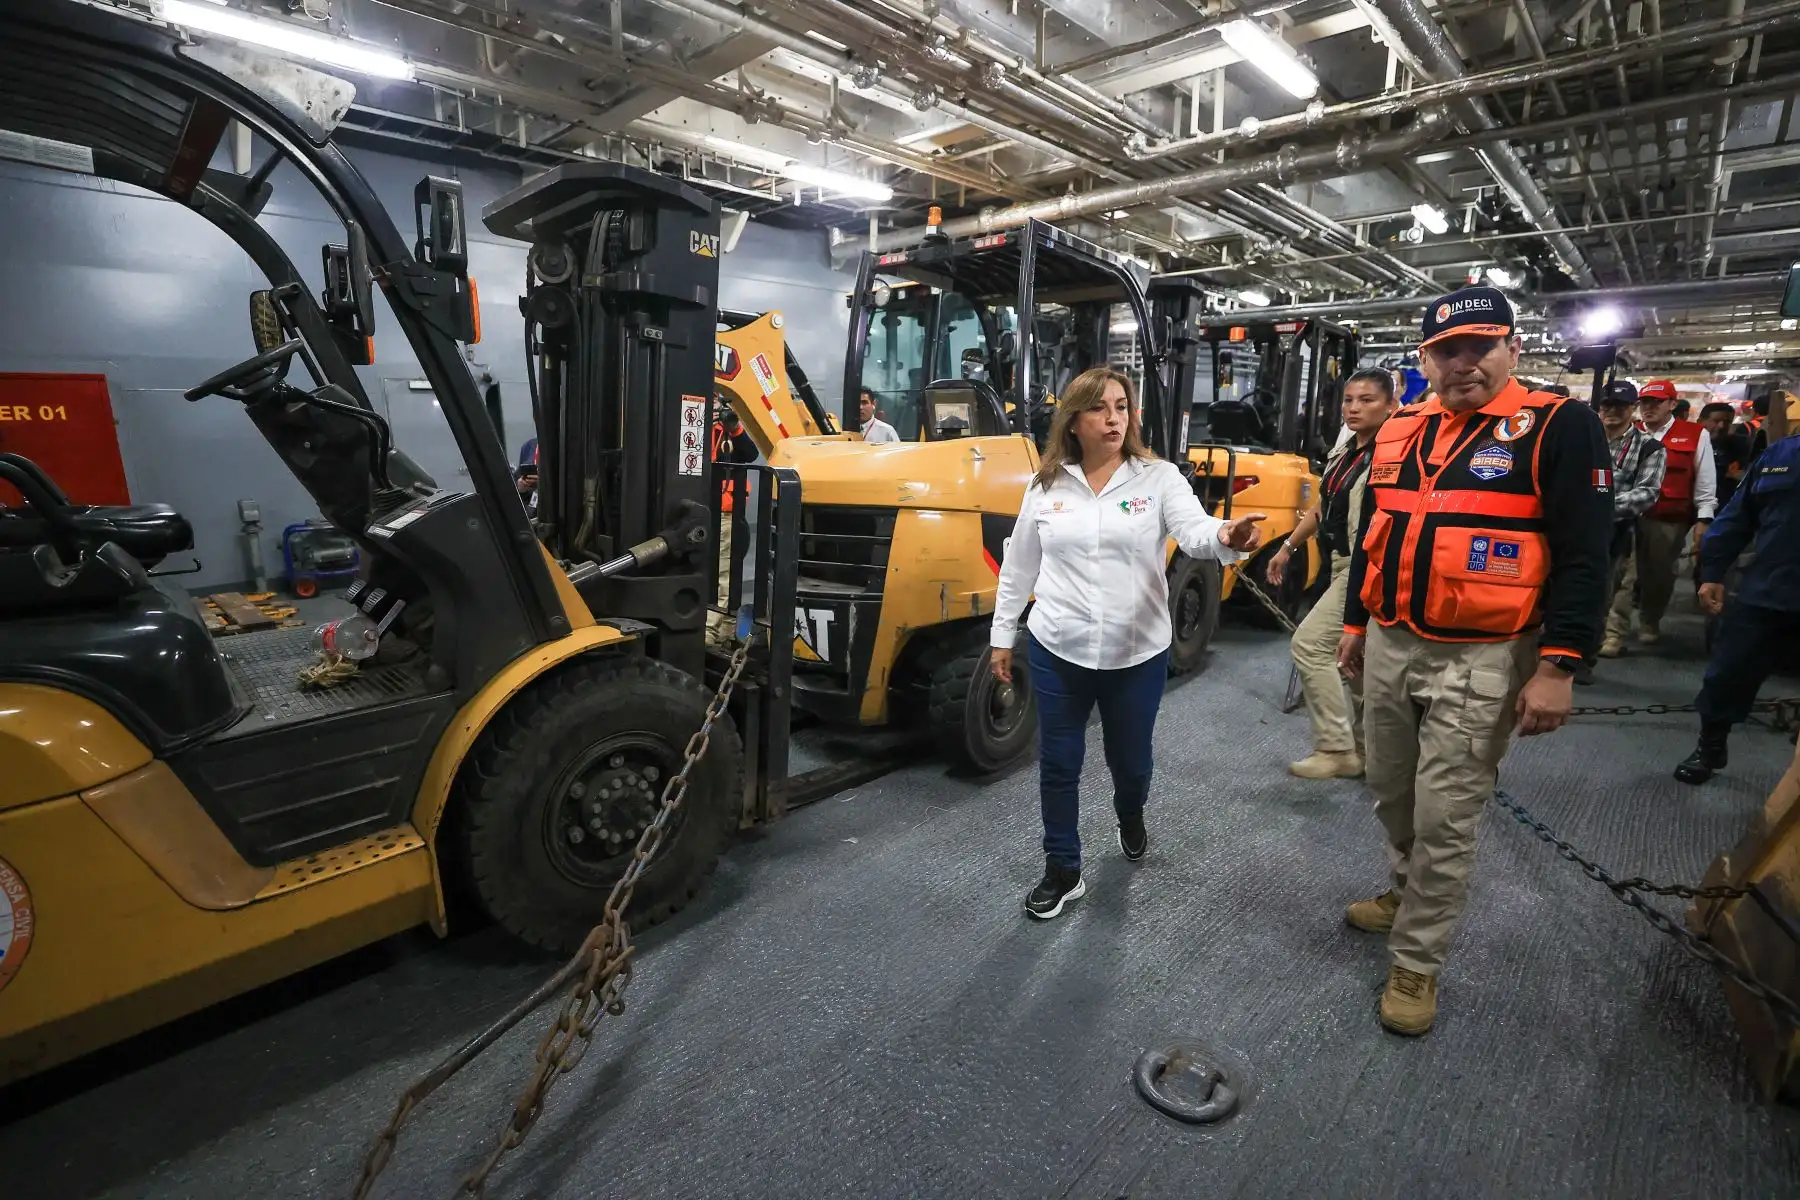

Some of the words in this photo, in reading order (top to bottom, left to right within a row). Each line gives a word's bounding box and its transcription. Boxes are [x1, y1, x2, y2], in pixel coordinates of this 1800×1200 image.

[690, 230, 720, 258] CAT
[1451, 299, 1493, 312] INDECI
[38, 405, 67, 421] 01
[1472, 456, 1510, 468] GIRED
[793, 607, 835, 662] AT
[0, 863, 28, 905] ENSA
[14, 908, 33, 942] CIVIL
